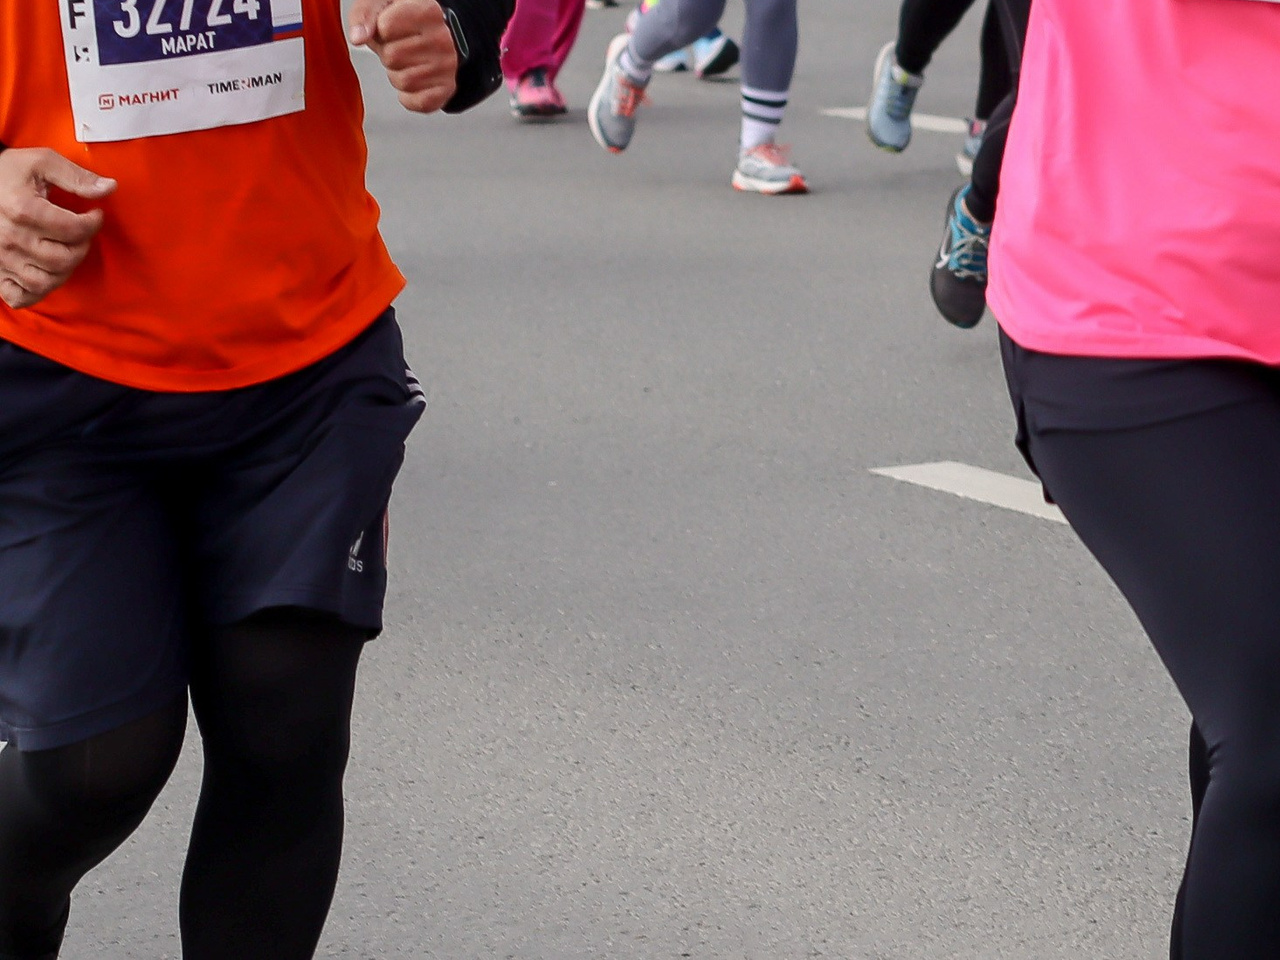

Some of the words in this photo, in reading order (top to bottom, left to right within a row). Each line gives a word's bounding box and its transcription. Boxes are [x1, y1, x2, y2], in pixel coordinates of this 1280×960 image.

[67, 0, 85, 29] F
[161, 31, 216, 55] МАРАТ
[119, 88, 179, 106] МАГНИТ
